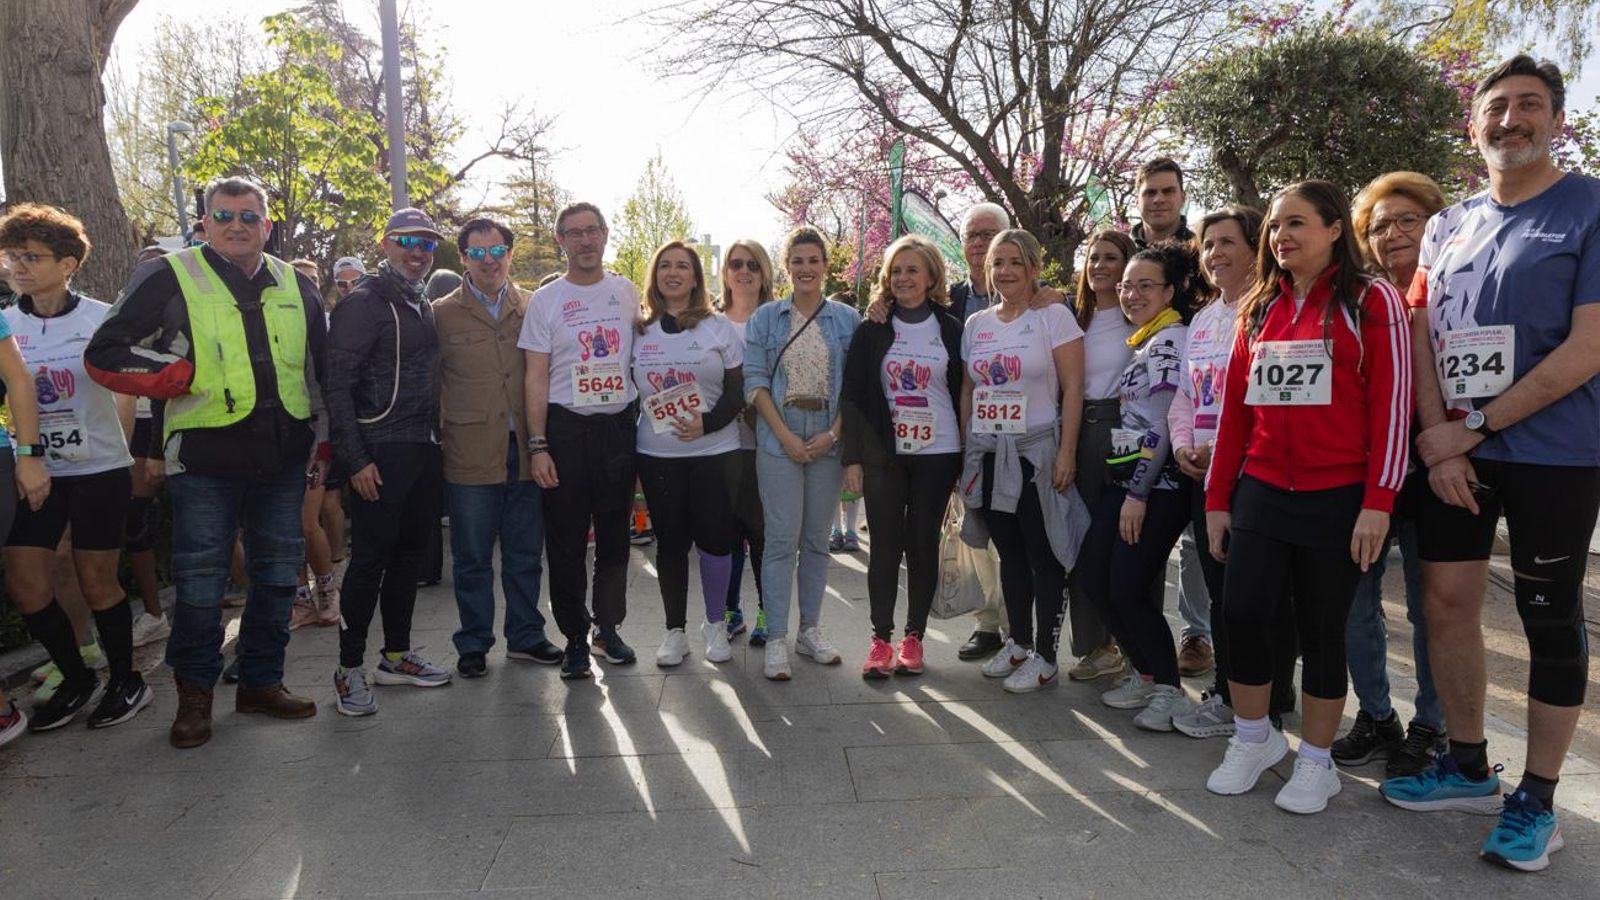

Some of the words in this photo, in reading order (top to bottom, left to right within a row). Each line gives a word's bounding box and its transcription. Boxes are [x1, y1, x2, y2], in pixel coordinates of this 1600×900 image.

[1254, 364, 1324, 386] 1027
[1439, 351, 1505, 380] 1234
[578, 375, 624, 393] 5642
[653, 393, 700, 420] 5815
[977, 404, 1021, 420] 5812
